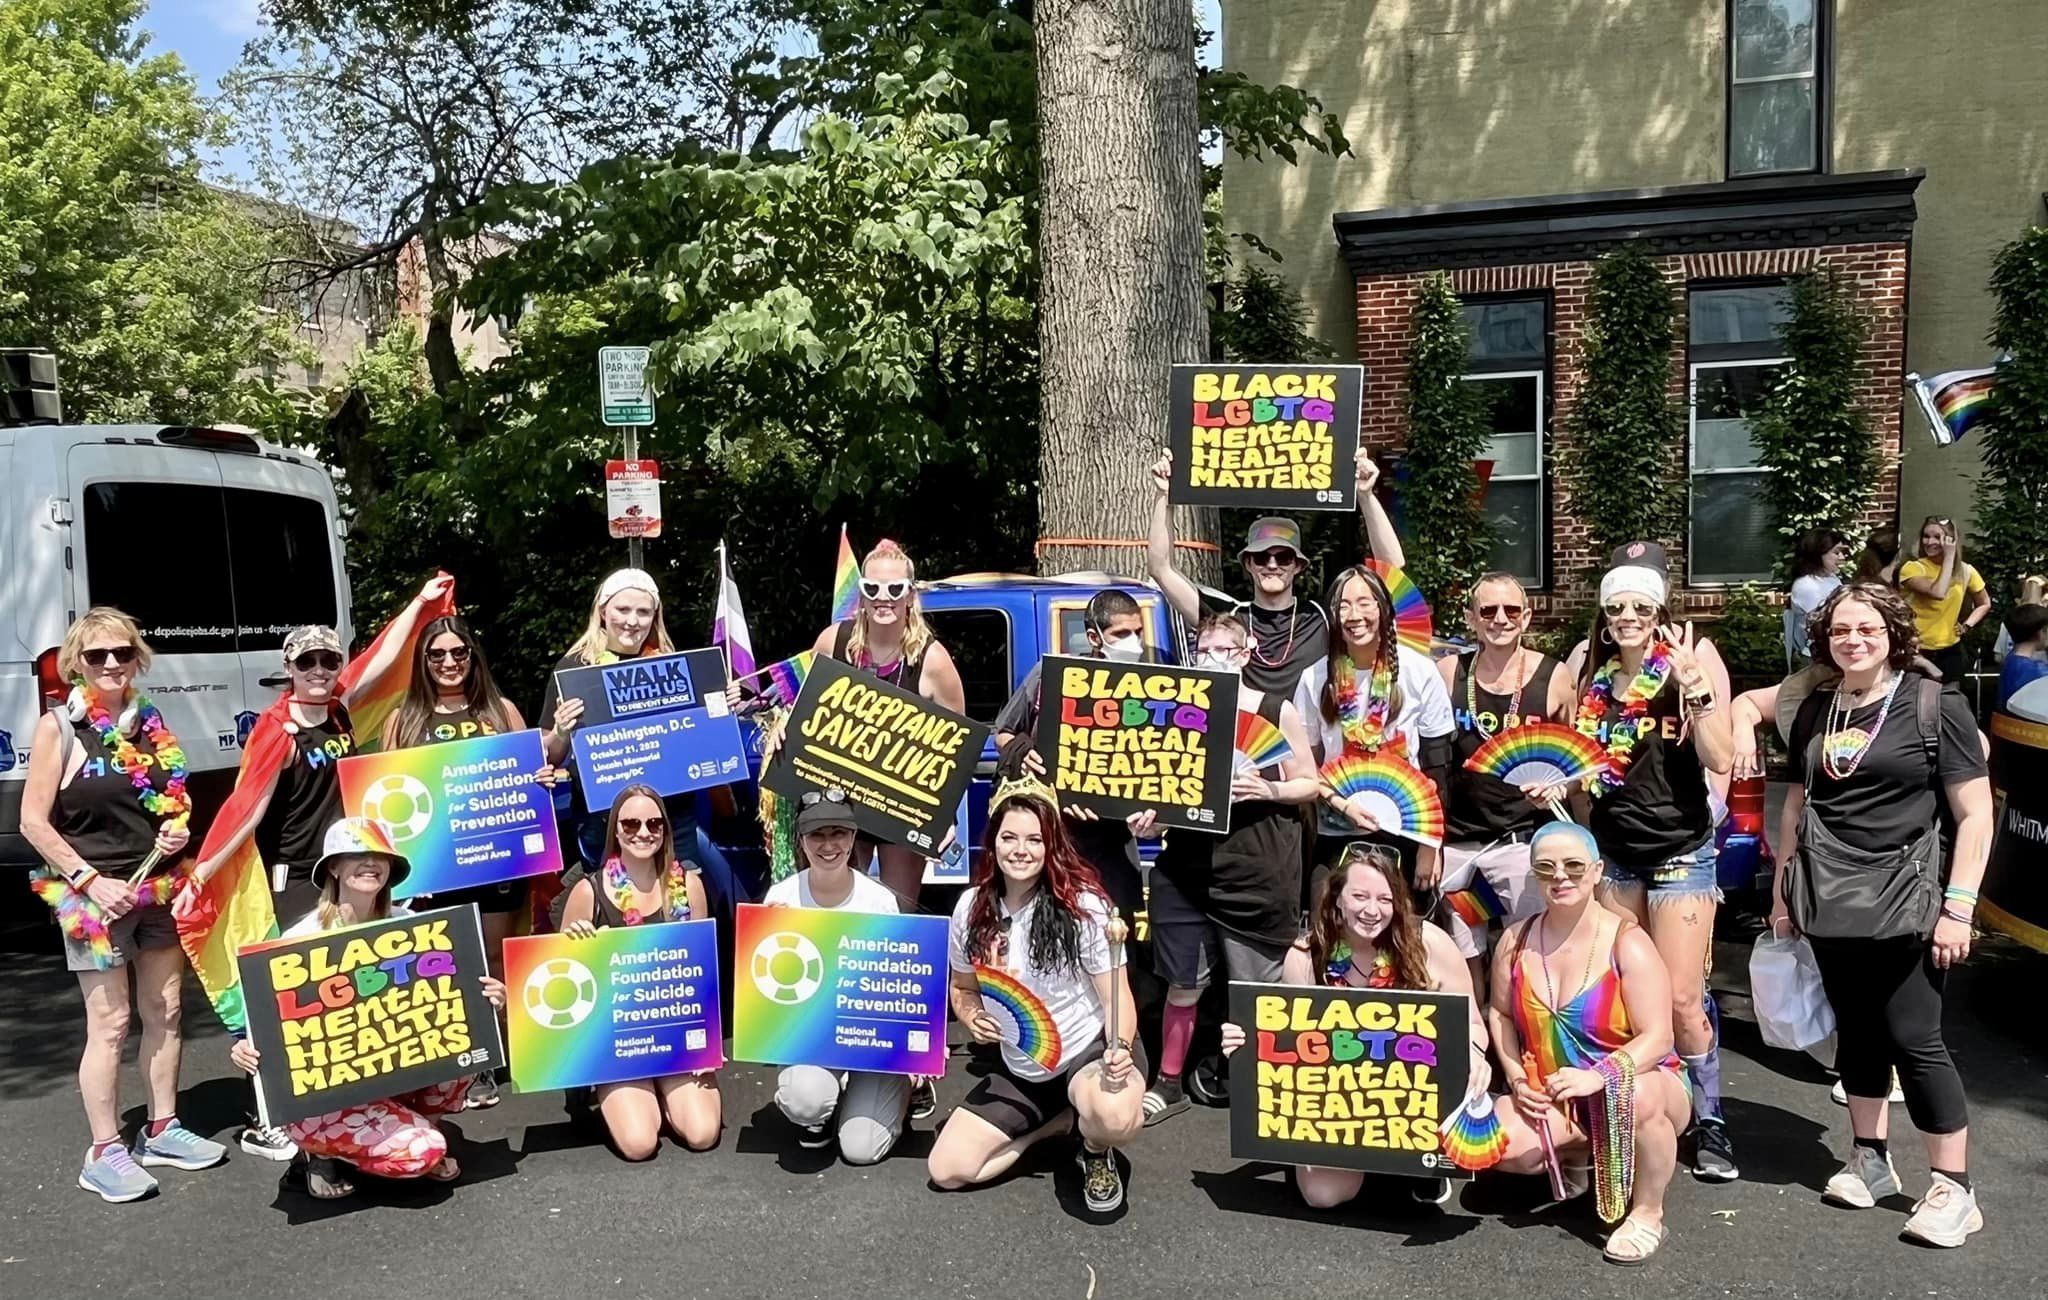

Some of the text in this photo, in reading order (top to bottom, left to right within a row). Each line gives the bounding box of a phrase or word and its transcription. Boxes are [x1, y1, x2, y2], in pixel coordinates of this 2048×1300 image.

[606, 352, 622, 361] TWO
[1193, 373, 1337, 402] BLACK
[1193, 397, 1334, 427] LGBTQ
[1191, 442, 1333, 469] HEALTH
[612, 472, 653, 480] PARKING
[1190, 463, 1331, 490] MATTERS
[606, 661, 687, 689] WALK
[148, 684, 210, 694] TRANSIT
[612, 679, 688, 703] WITH US
[1062, 666, 1212, 709] BLACK
[616, 704, 628, 713] TO
[818, 676, 970, 754] ACCEPTANCE
[1061, 697, 1208, 733] LGBTQ
[425, 721, 497, 741] OPE
[585, 717, 696, 747] Washington, D.C.
[307, 733, 350, 770] HOP
[590, 746, 625, 762] October
[625, 743, 638, 754] 21,
[801, 706, 957, 792] SAVES LIVES
[441, 757, 518, 779] American
[593, 752, 661, 772] Lincoln Memorial
[1058, 745, 1206, 779] HEALTH
[443, 773, 534, 797] Foundation
[1055, 767, 1204, 806] MATTERS
[448, 791, 528, 814] for Suicide
[450, 807, 536, 832] Prevention
[455, 842, 493, 856] National
[456, 849, 511, 865] Capital Area
[269, 920, 453, 991] BLACK
[609, 947, 688, 966] American
[838, 935, 919, 954] American
[610, 964, 703, 986] Foundation
[838, 955, 933, 975] Foundation
[275, 951, 457, 1020] LGBTQ
[612, 983, 695, 1004] for Suicide
[836, 977, 922, 995] for Suicide
[613, 1002, 701, 1023] Prevention
[836, 994, 928, 1015] Prevention
[1255, 995, 1437, 1039] BLACK
[285, 998, 466, 1070] HEALTH
[615, 1035, 654, 1048] National
[835, 1025, 876, 1037] National
[835, 1036, 893, 1049] Capital Area
[290, 1022, 471, 1096] MATTERS
[615, 1044, 672, 1058] Capital Area
[1257, 1030, 1437, 1066] LGBTQ
[1258, 1086, 1438, 1119] HEALTH
[1258, 1111, 1439, 1151] MATTERS
